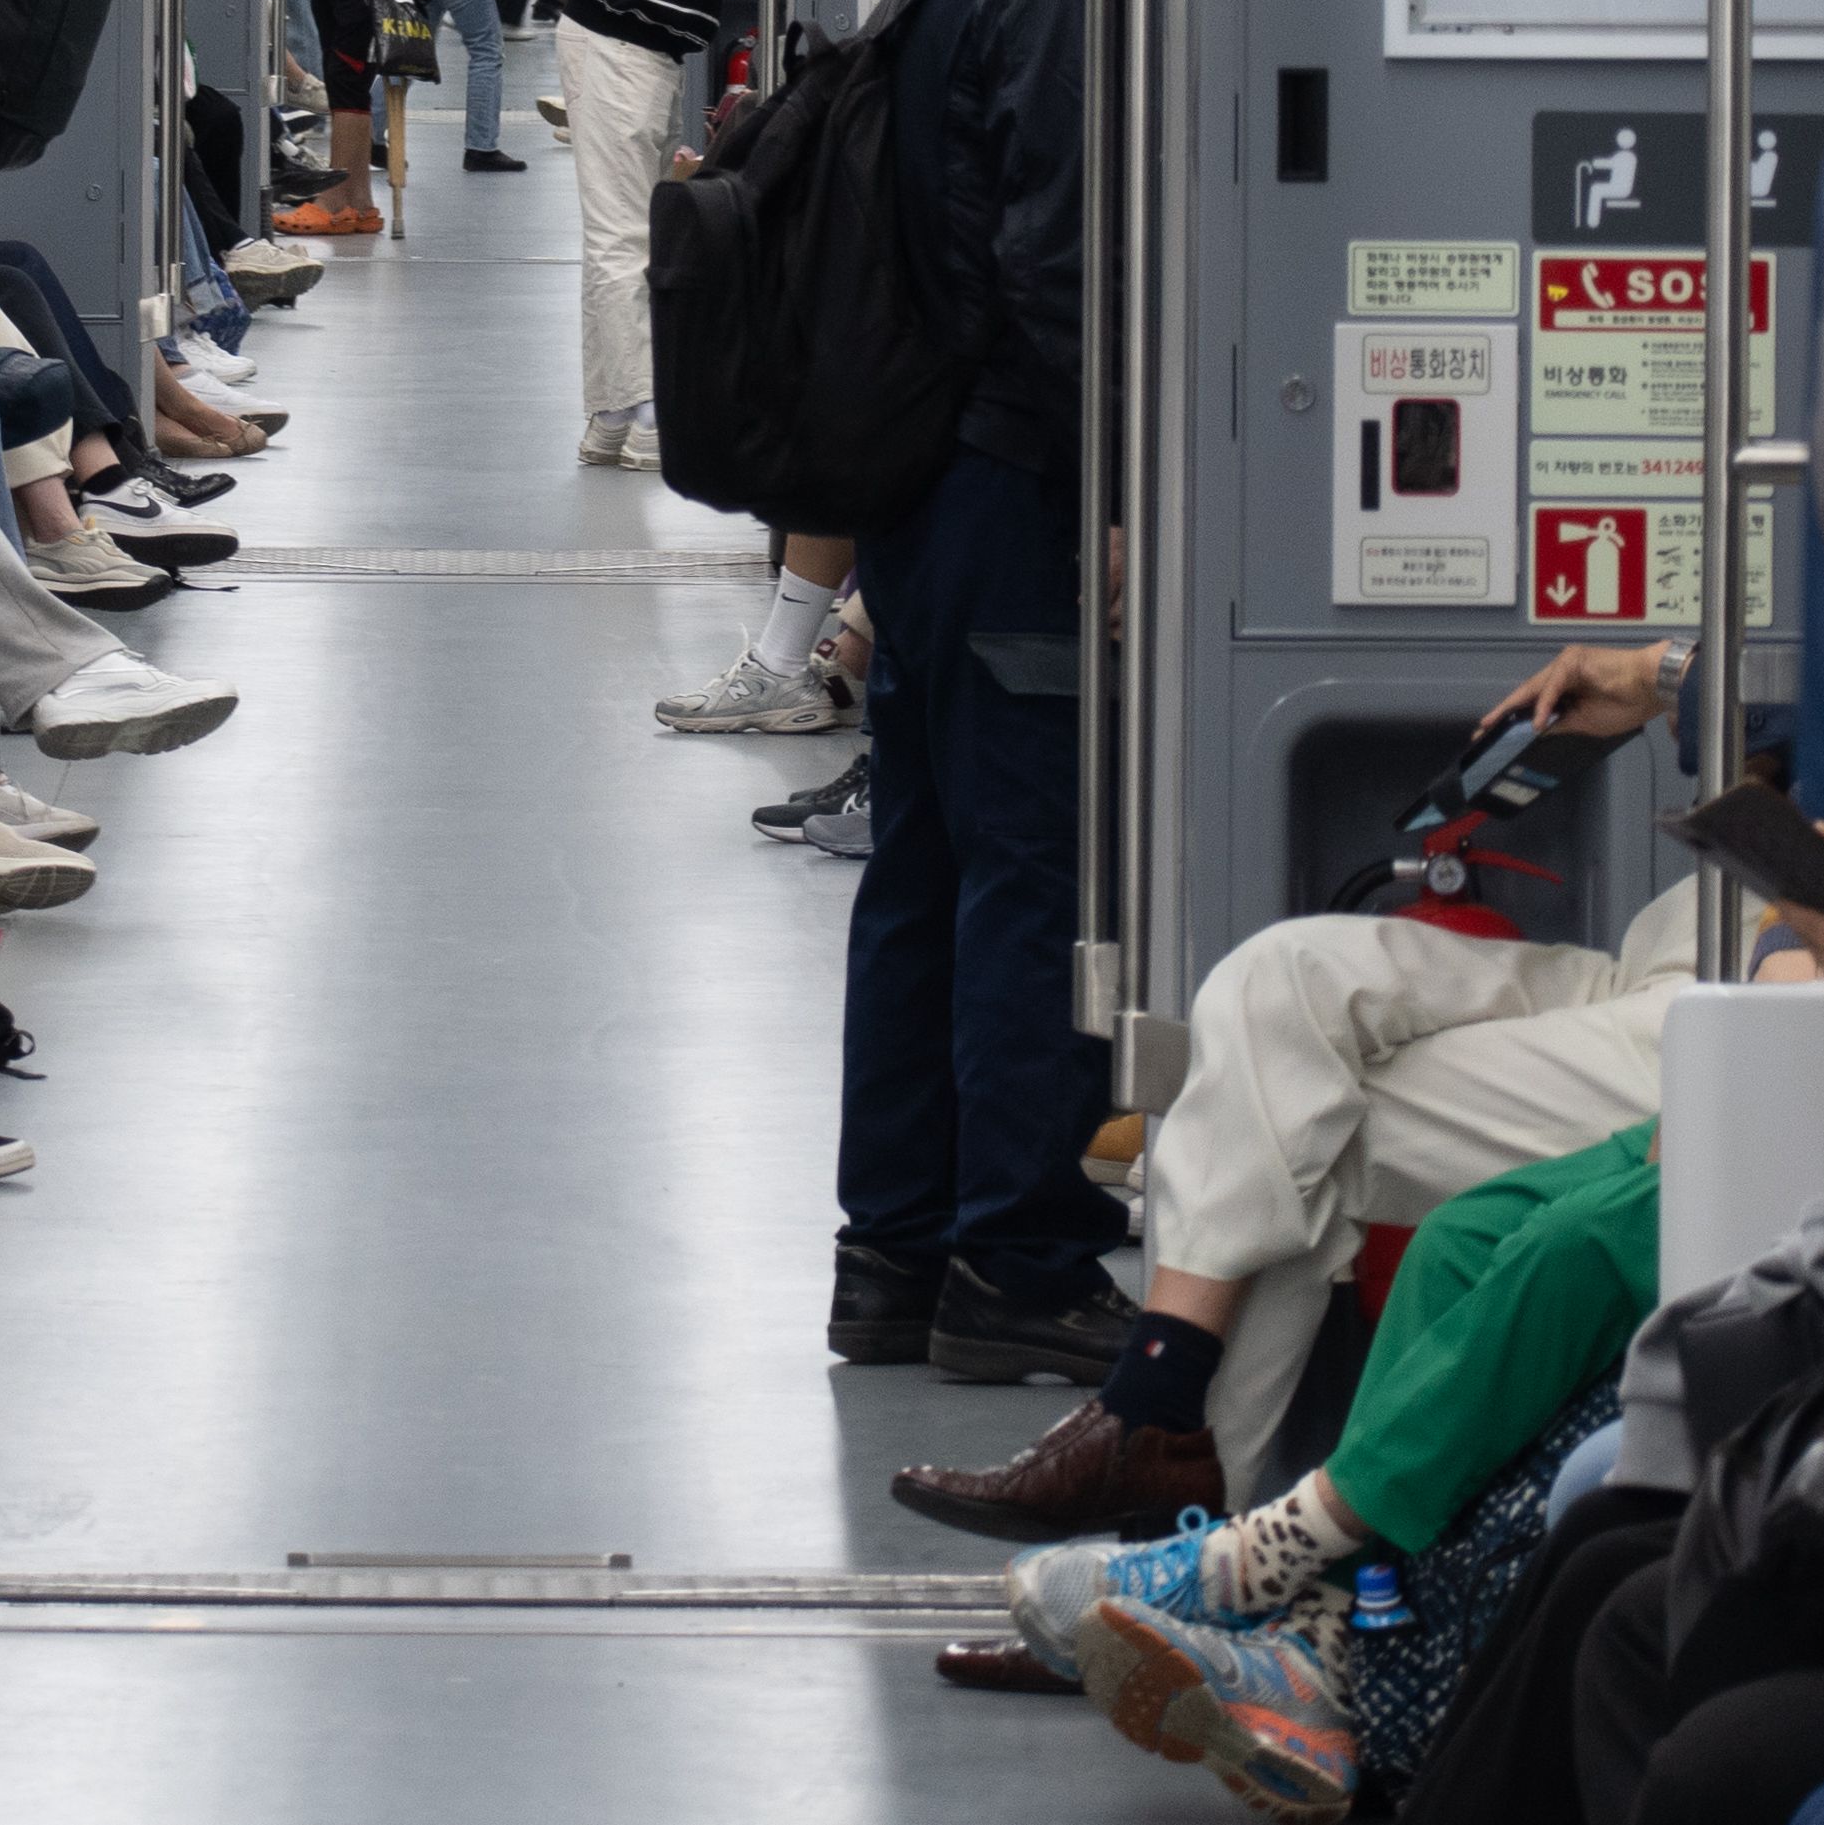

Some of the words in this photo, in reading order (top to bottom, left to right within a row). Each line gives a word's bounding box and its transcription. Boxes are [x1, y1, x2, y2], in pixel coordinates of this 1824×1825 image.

[1626, 268, 1707, 304] SO
[1370, 347, 1486, 381] 비상통화장치
[1544, 365, 1628, 387] 비상통화
[1535, 460, 1549, 475] 이
[1554, 460, 1594, 475] 차량의
[1599, 460, 1639, 475] 번호는
